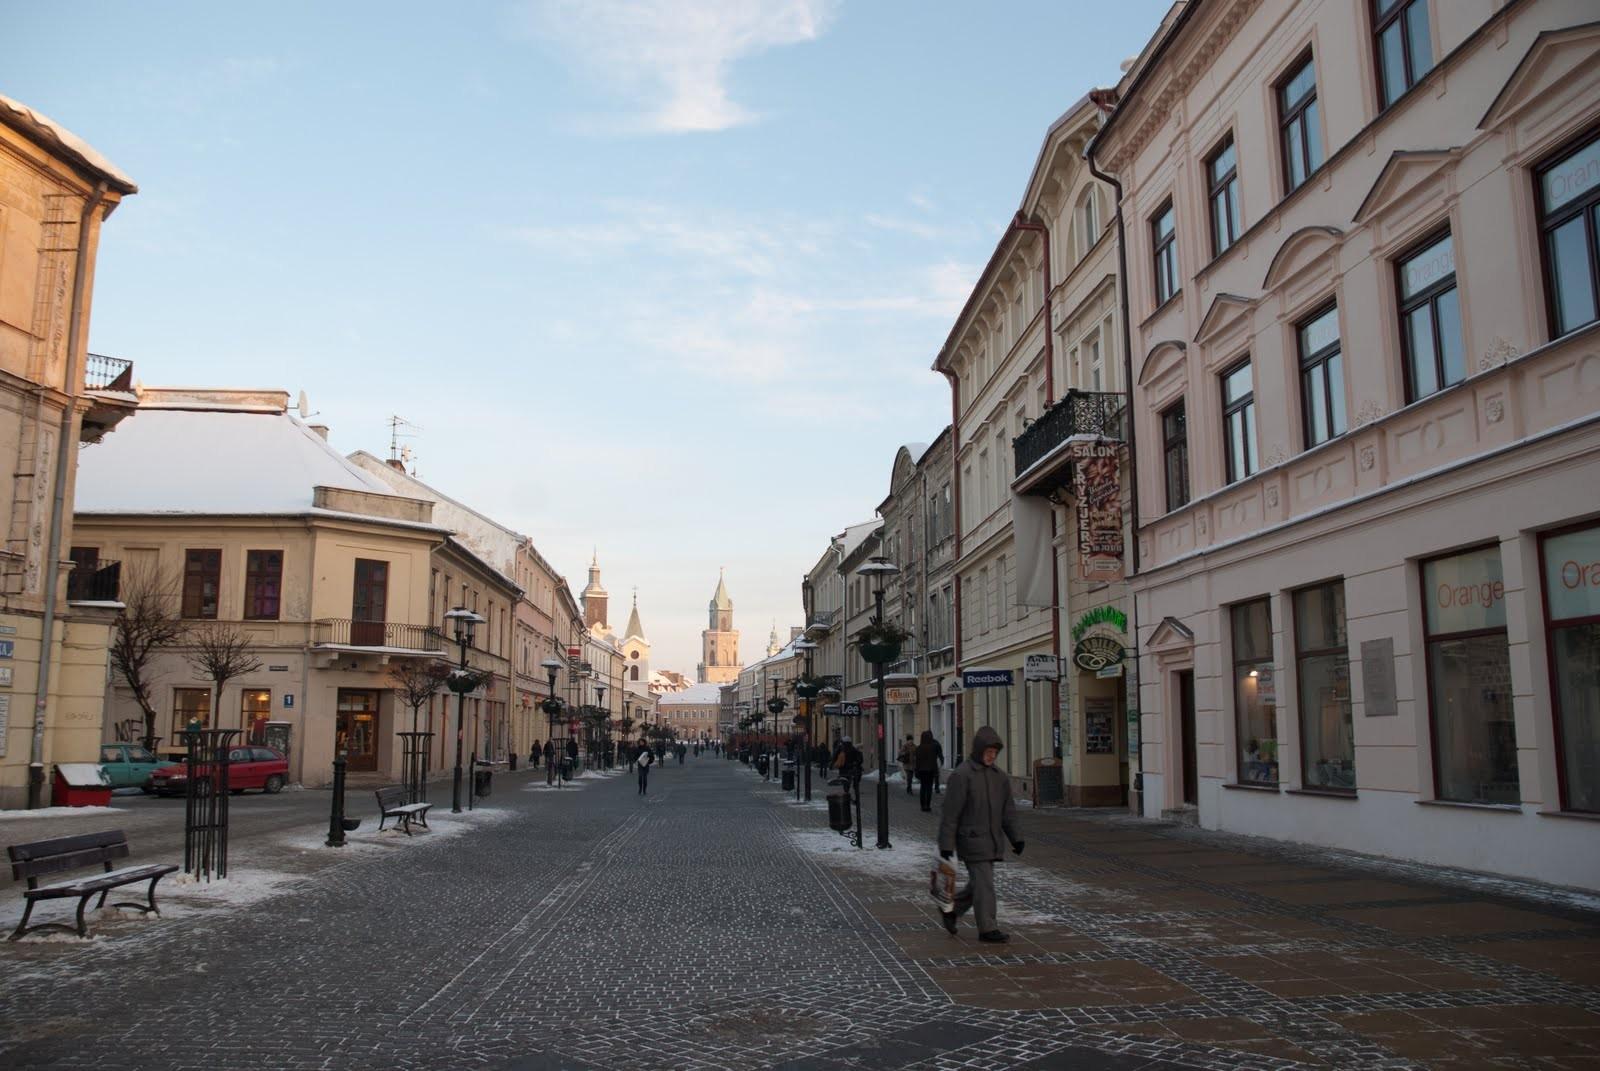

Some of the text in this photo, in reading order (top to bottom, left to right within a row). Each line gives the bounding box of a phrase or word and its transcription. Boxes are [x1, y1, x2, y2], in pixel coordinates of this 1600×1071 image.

[1073, 445, 1116, 458] SALON
[1076, 462, 1090, 577] FRYZJERSKI
[1438, 581, 1504, 609] Orange
[967, 673, 1009, 684] Reebok
[286, 695, 291, 704] 1
[841, 703, 859, 715] Lee
